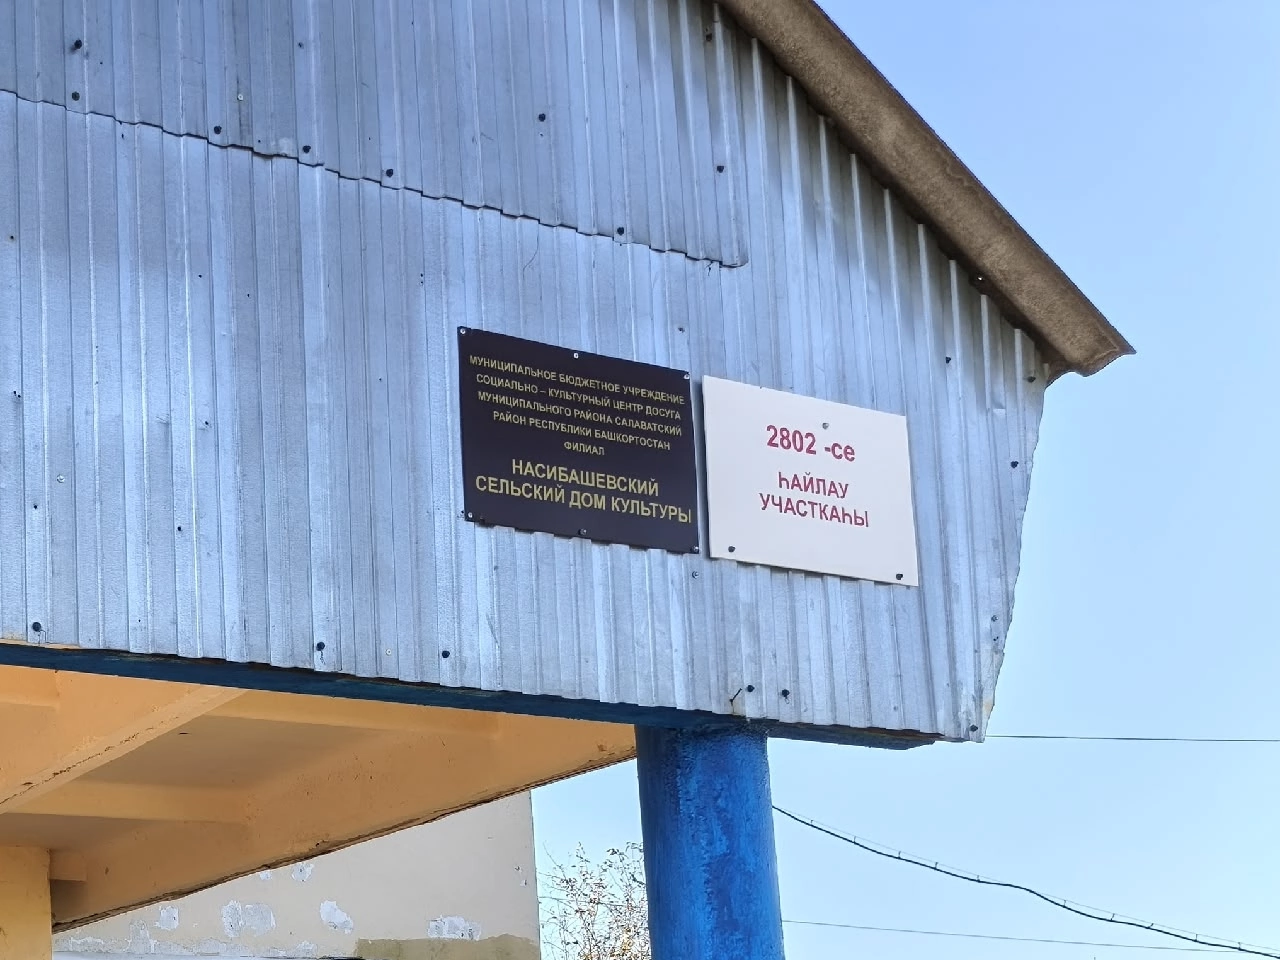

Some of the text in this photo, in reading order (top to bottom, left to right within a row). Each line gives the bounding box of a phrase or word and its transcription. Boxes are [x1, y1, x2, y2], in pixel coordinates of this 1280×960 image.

[470, 355, 685, 405] МУНИЦИПАЛЬНОЕ БЮДЖЕТНОЕ УЧРЕЖДЕНИЕ
[476, 373, 538, 393] СОЦИАЛЬНО
[548, 388, 610, 408] КУЛЬТУРНЫЙ
[613, 400, 643, 414] ЦЕНТР
[645, 406, 681, 420] ДОСУГА
[478, 391, 682, 437] МУНИЦИПАЛЬНОГО РАЙОНА САЛАВАТСКИЙ
[493, 410, 671, 451] РАЙОН РЕСПУБЛИКИ БАШКОРТОСТАН
[564, 441, 605, 456] ФИЛИАЛ
[766, 424, 817, 455] 2802
[512, 459, 659, 497] НАСИБАШЕВСКИЙ
[475, 475, 692, 524] СЕЛЬСКИЙ ДОМ КУЛЬТУРЫ
[759, 492, 869, 528] УЧАСТКАҺЫ
